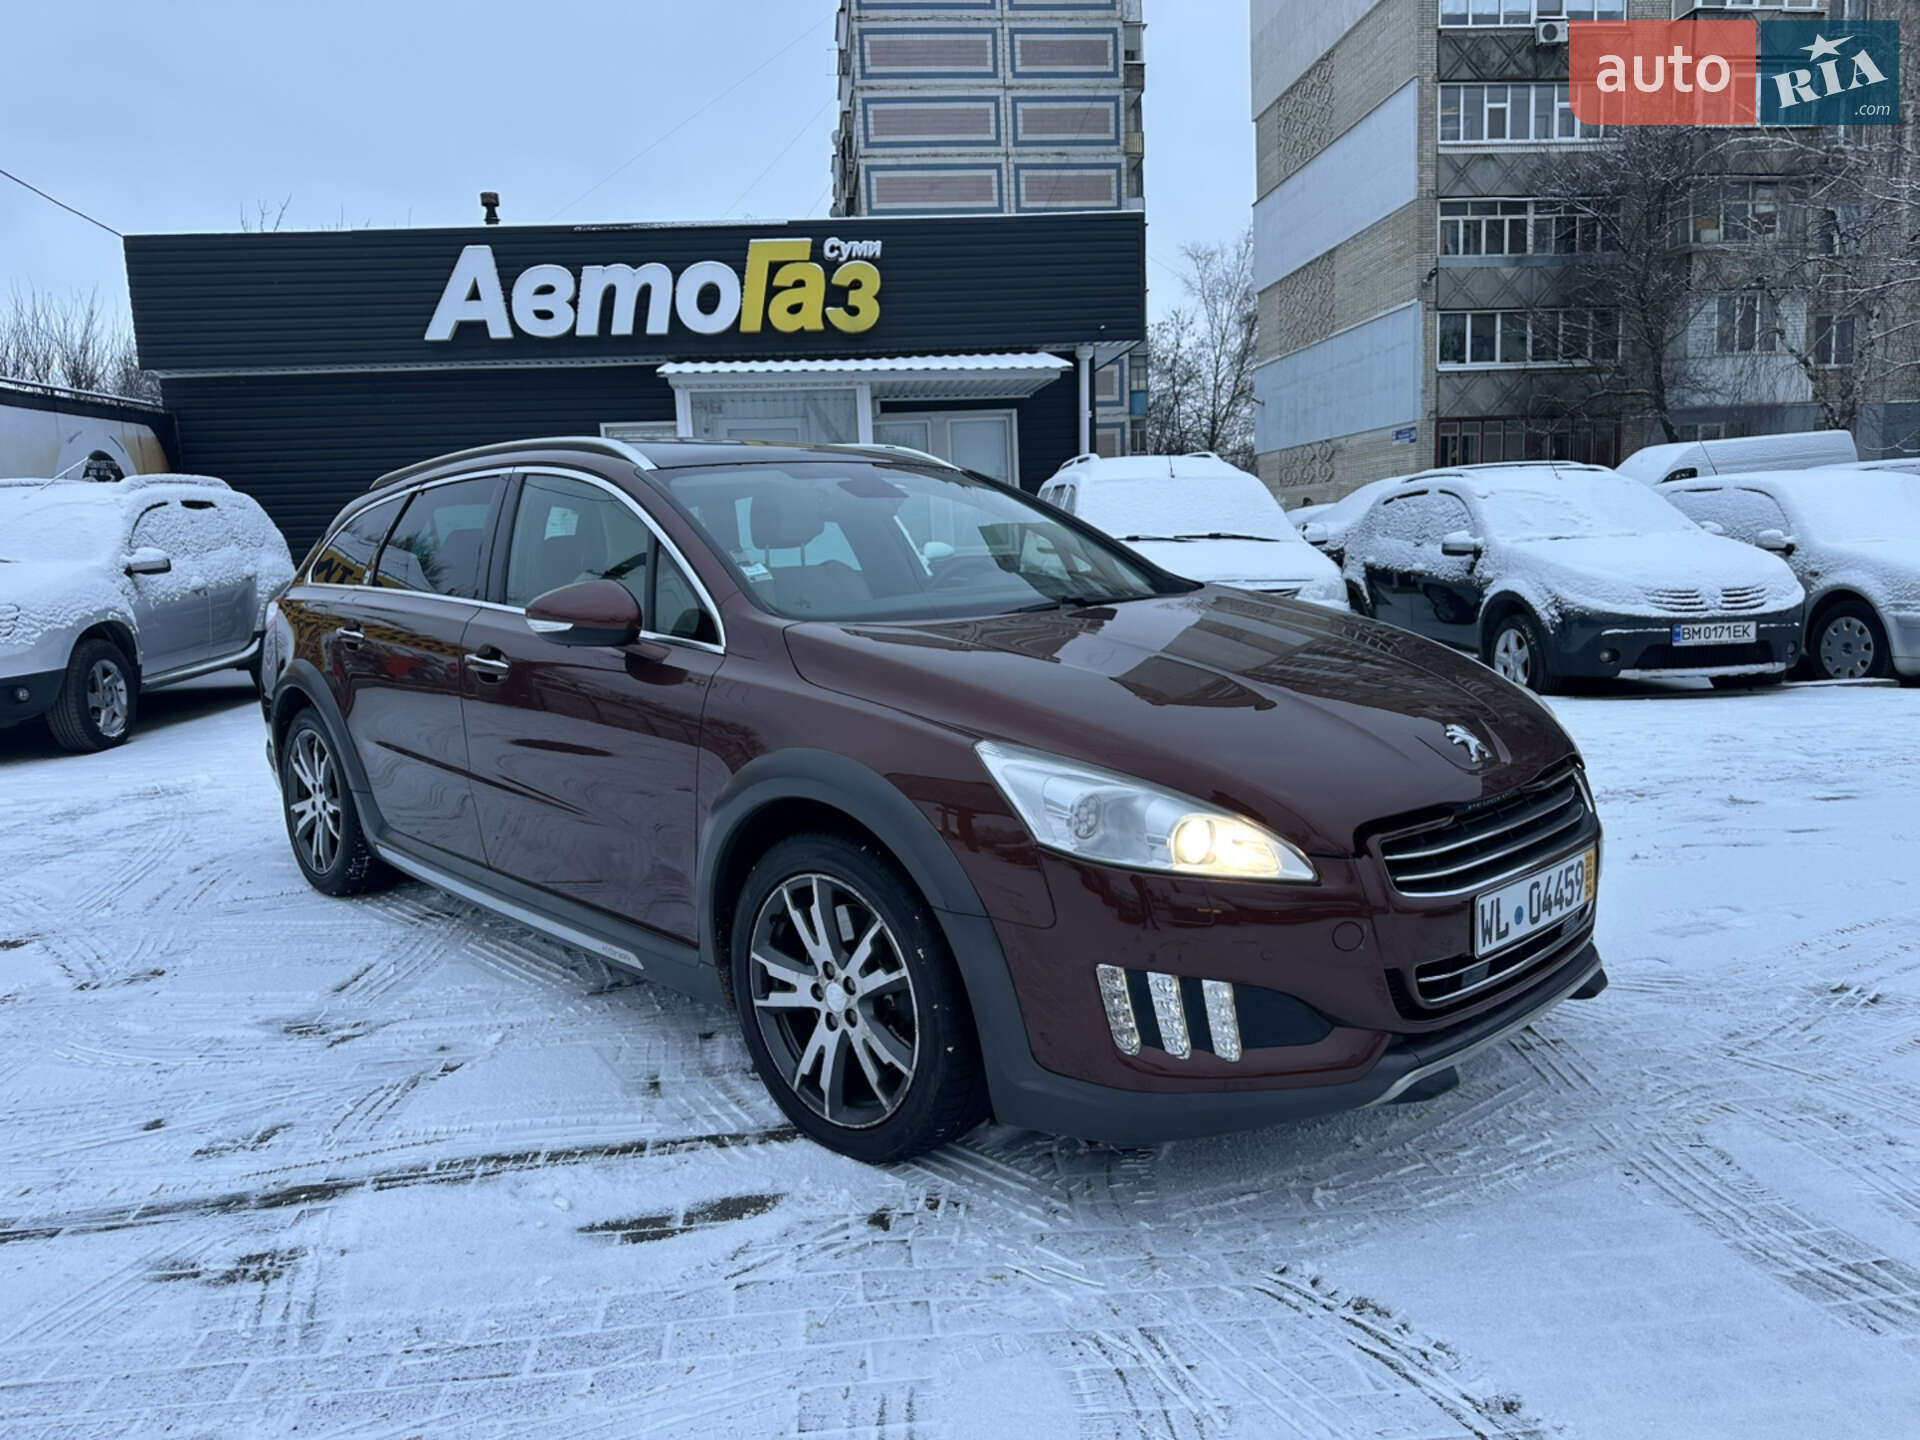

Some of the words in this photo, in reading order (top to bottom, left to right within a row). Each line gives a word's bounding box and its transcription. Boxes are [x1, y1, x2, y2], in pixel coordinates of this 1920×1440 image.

[424, 238, 882, 341] АвтоГаз
[823, 236, 882, 262] Суми
[1480, 897, 1509, 947] WL
[1529, 860, 1584, 925] 04459
